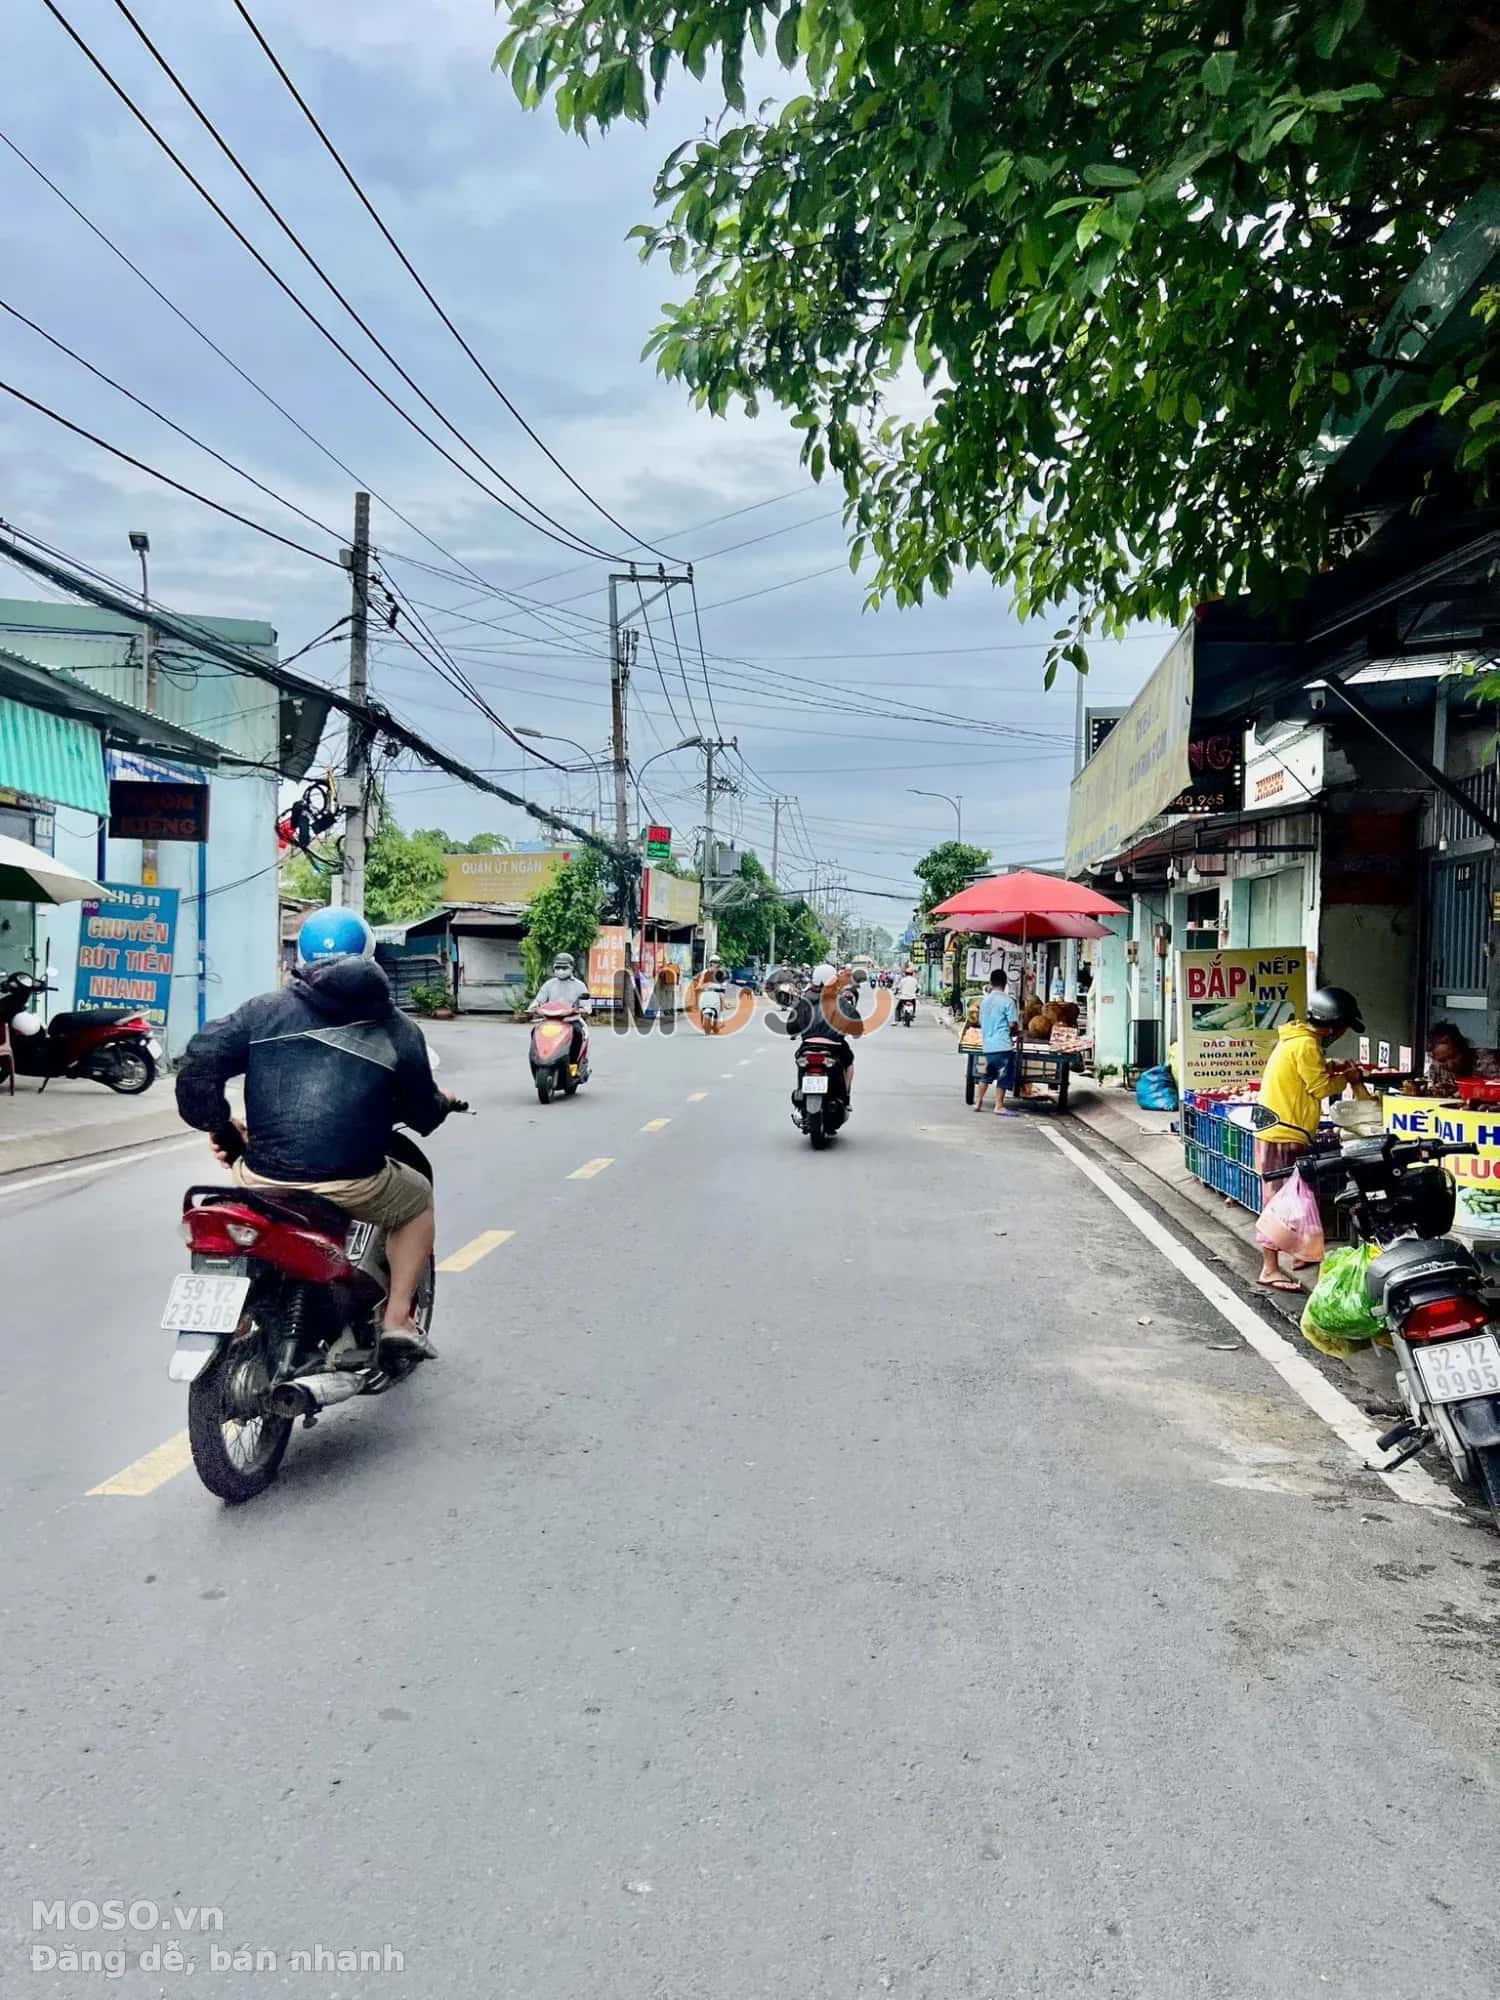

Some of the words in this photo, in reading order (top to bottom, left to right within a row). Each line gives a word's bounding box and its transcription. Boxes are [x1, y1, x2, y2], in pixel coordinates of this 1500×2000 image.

[88, 913, 169, 944] CHUYỂN
[79, 943, 120, 970] RÚT
[89, 975, 157, 1002] NHANH
[1186, 953, 1248, 1000] BẮP
[1258, 955, 1300, 975] NẾP
[1259, 982, 1289, 1001] MỸ
[1199, 1051, 1232, 1059] KHOAI
